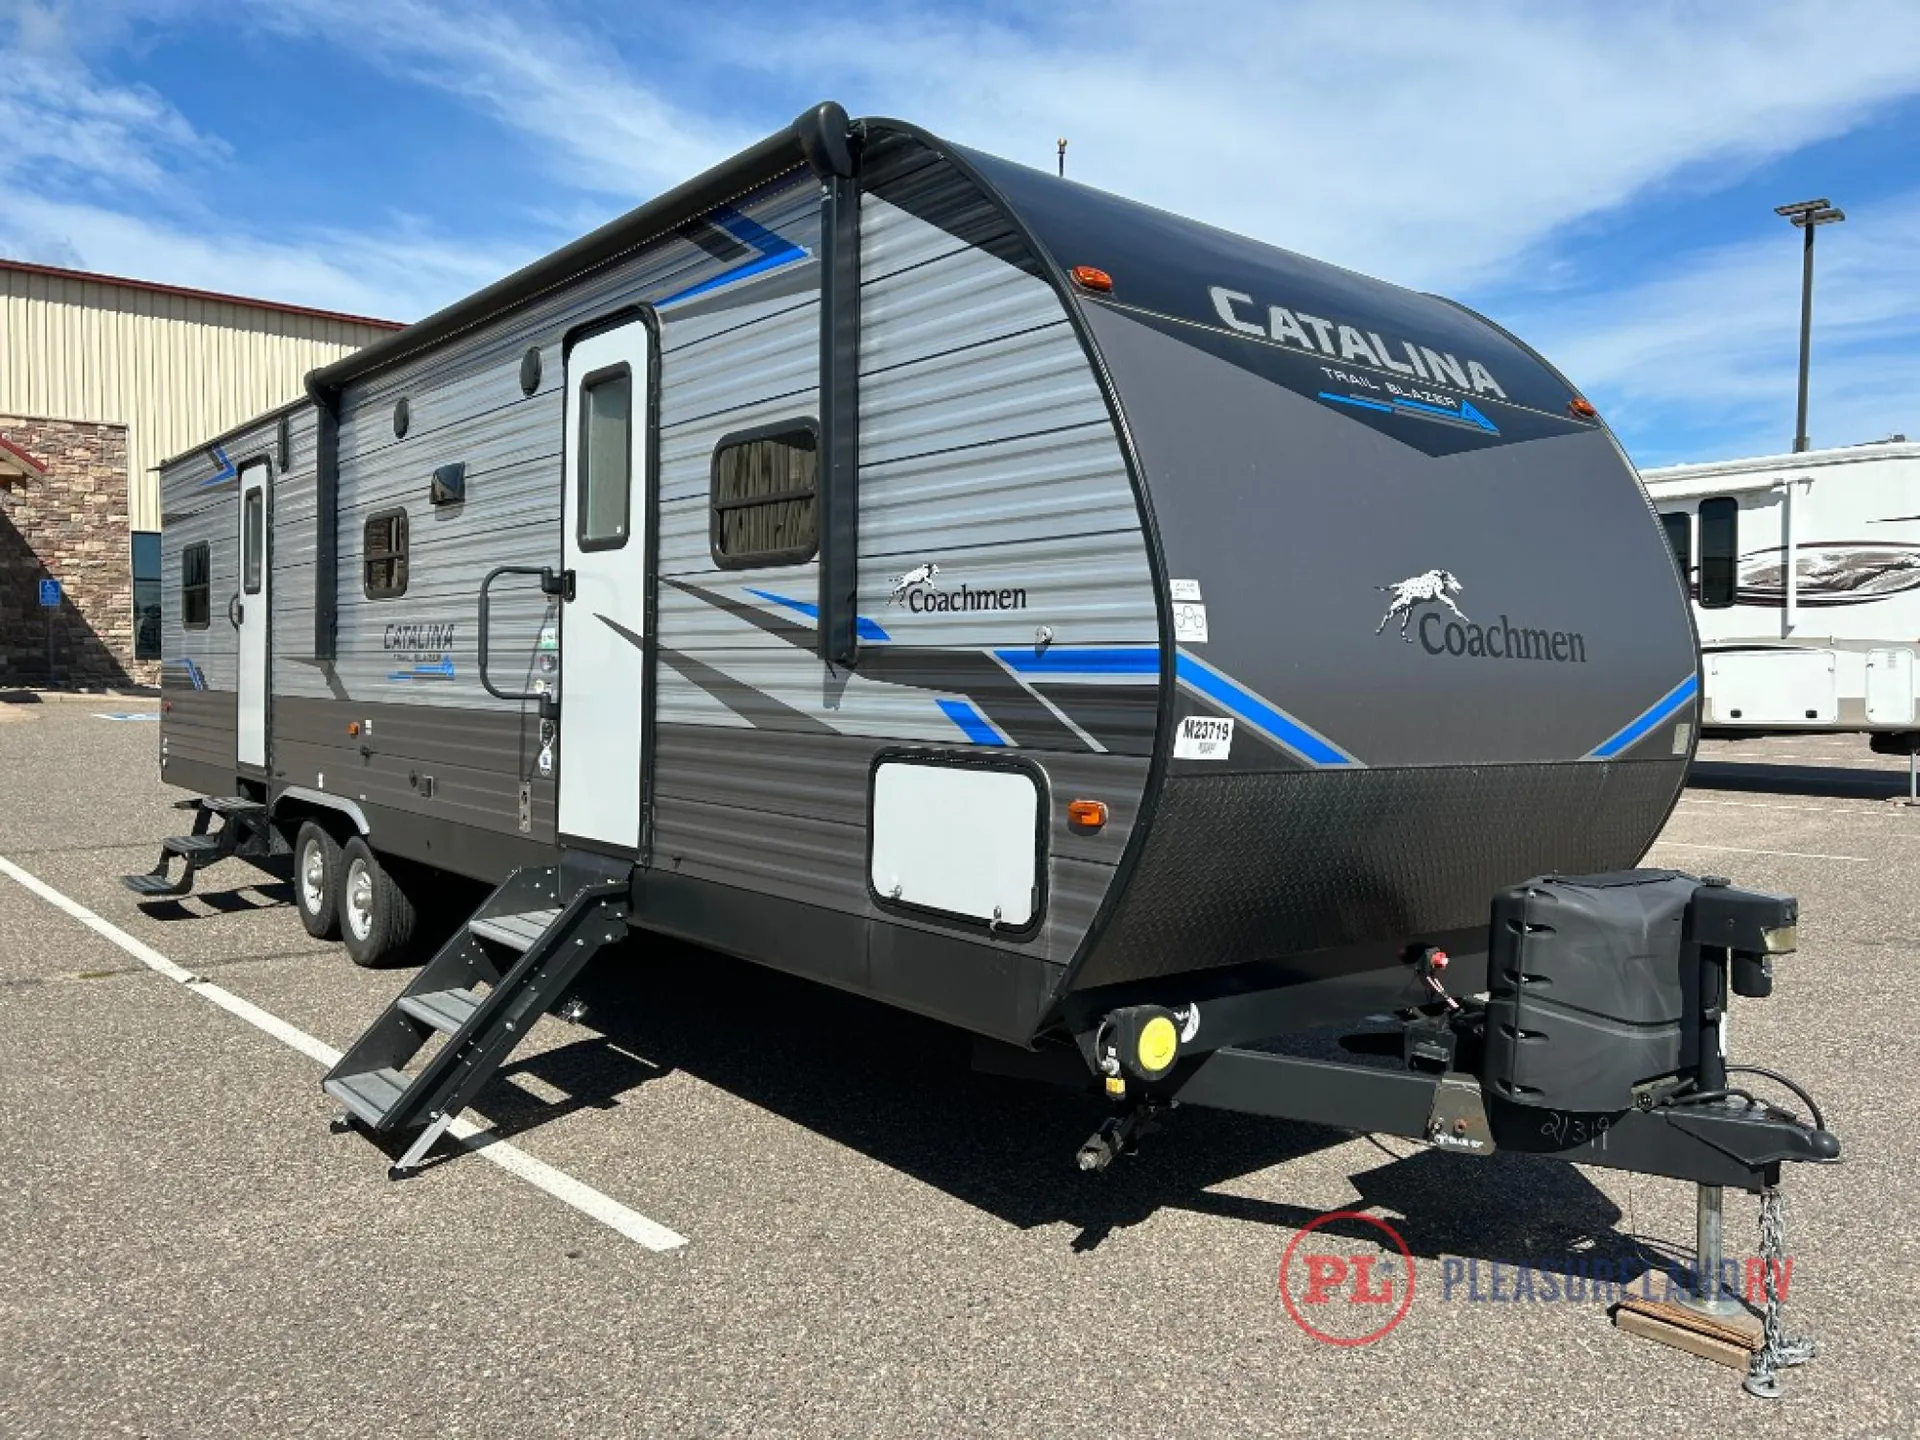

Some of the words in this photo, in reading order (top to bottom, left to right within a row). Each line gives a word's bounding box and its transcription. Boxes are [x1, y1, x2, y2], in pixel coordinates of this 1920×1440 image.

[1209, 285, 1507, 399] CATALINA
[1320, 366, 1381, 391] TRAIL
[1384, 381, 1458, 408] BLAZER
[908, 583, 1027, 614] Coachmen
[383, 623, 455, 649] CATALINA
[1418, 612, 1587, 663] Coachmen
[1183, 719, 1230, 742] M23719
